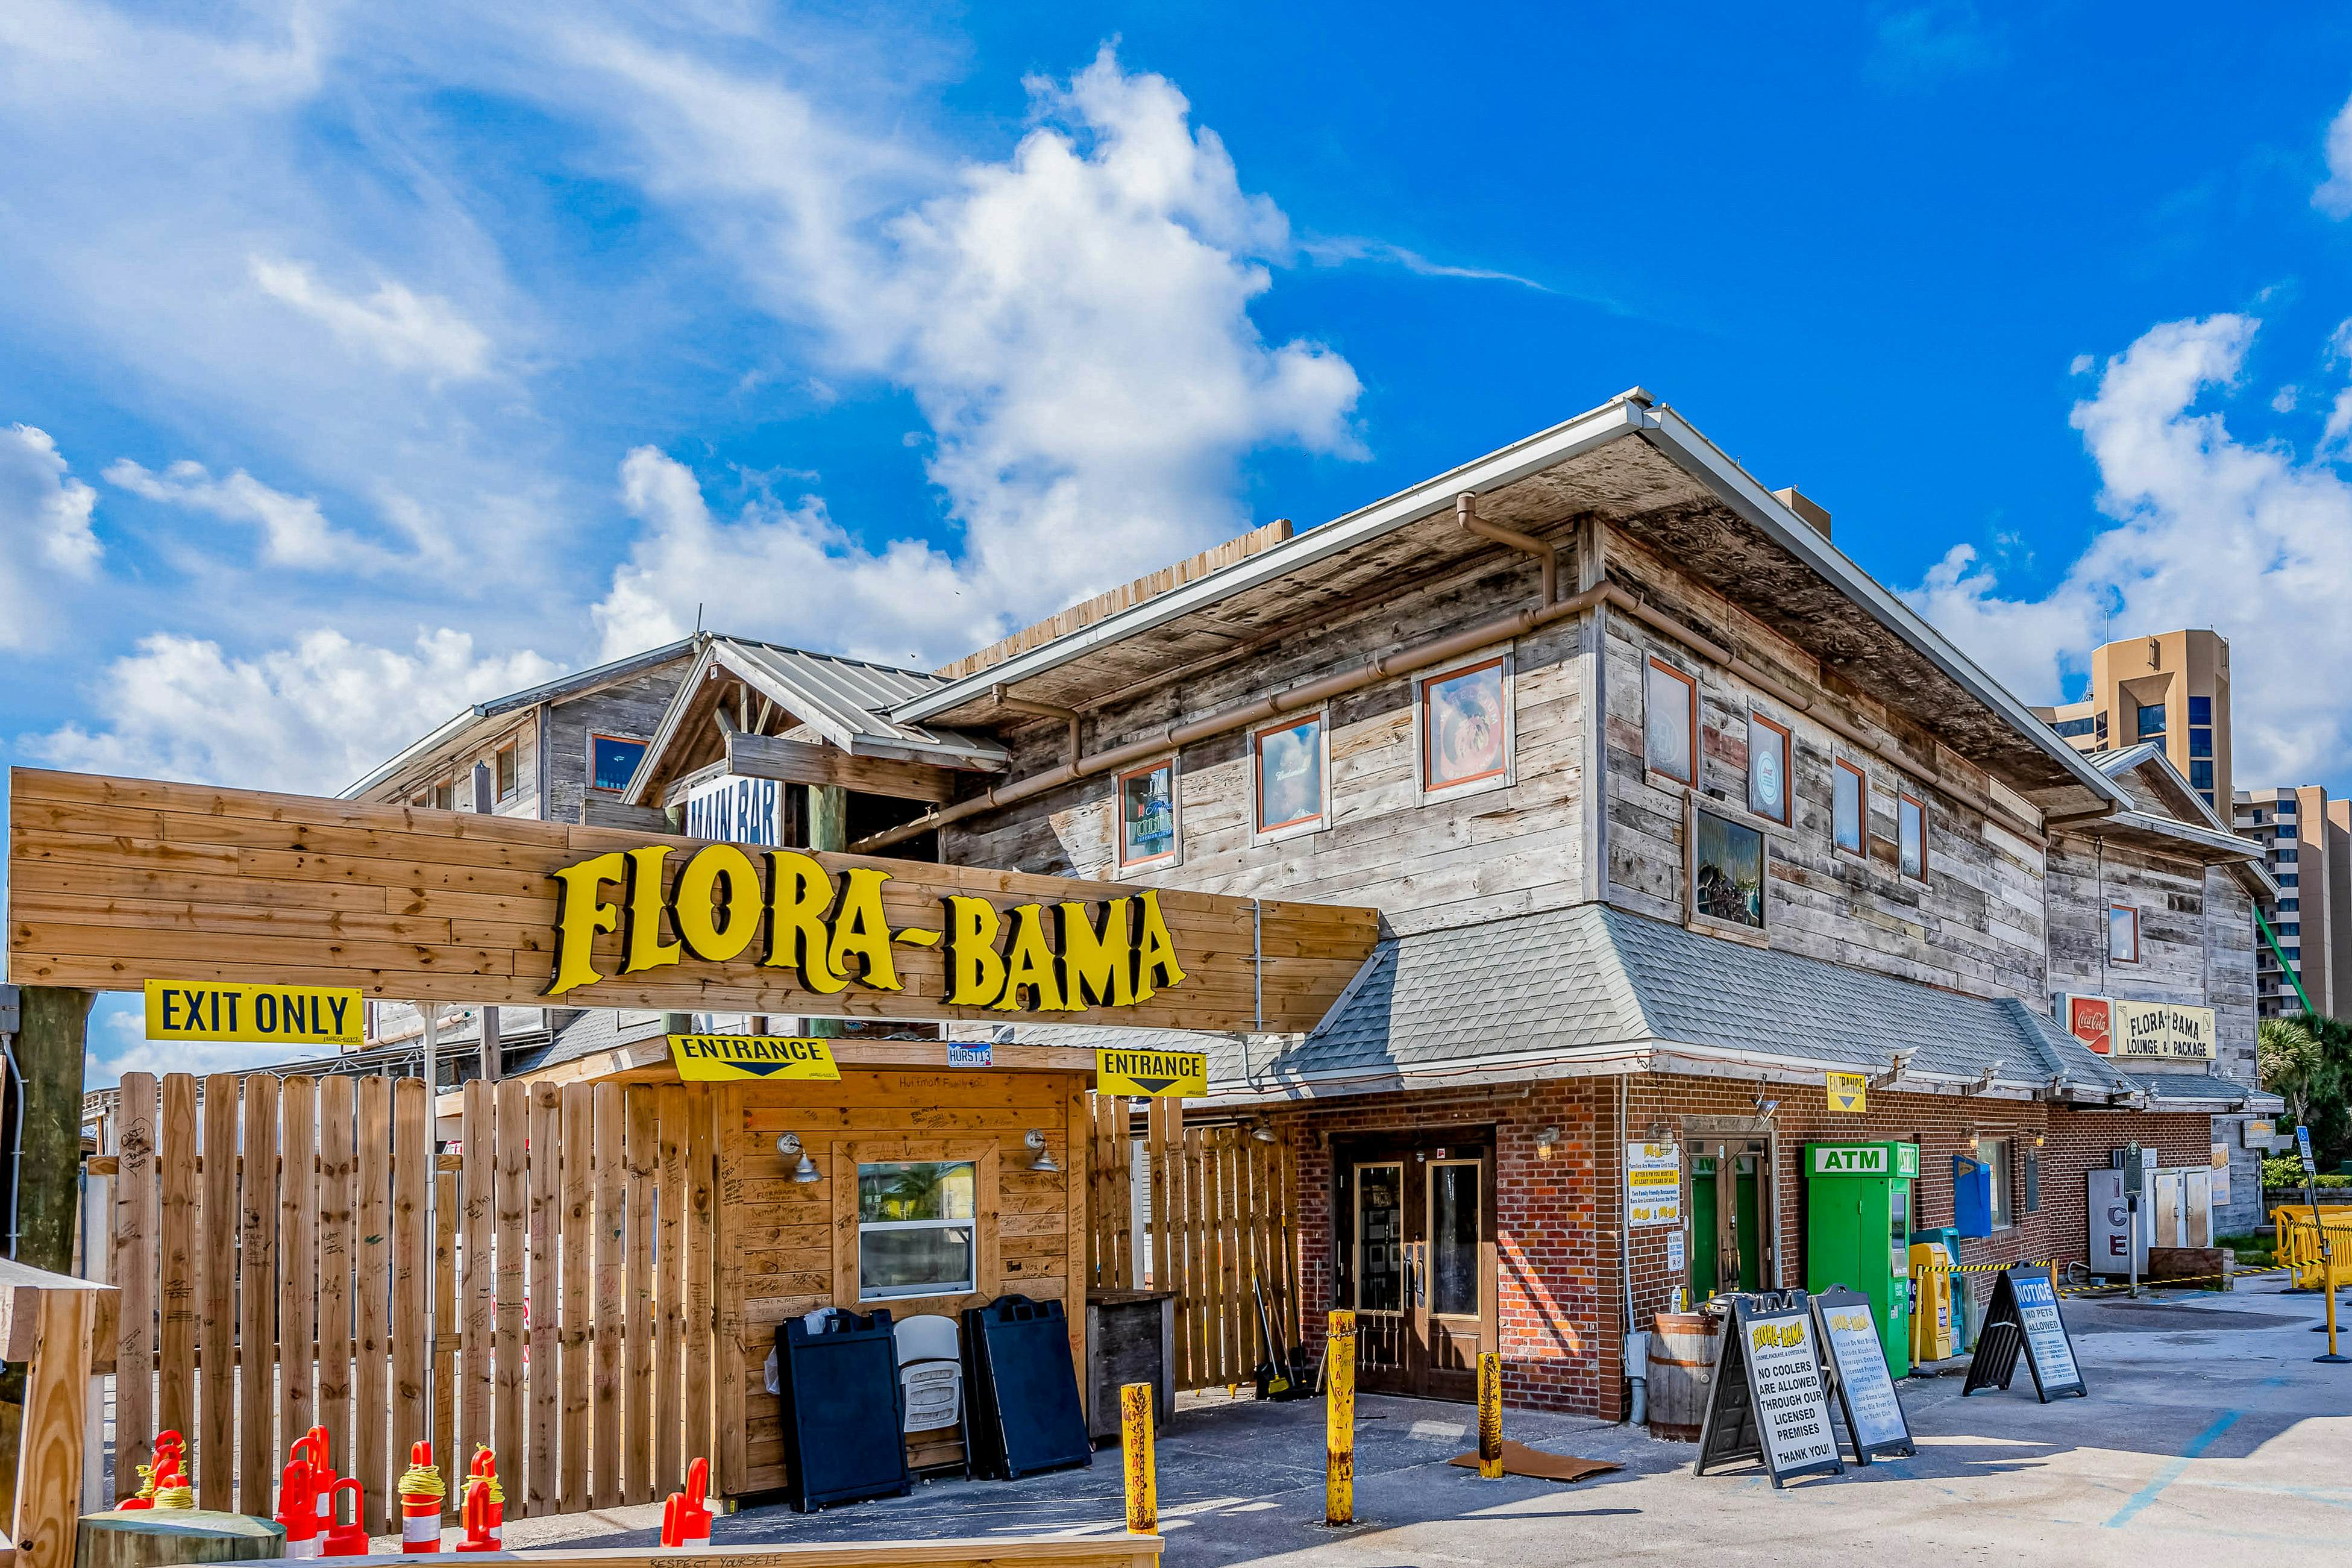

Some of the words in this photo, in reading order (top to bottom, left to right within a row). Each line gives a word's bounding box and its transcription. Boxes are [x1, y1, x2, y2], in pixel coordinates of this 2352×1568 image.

[691, 785, 733, 841] MAIN
[738, 779, 775, 846] BAR
[162, 989, 242, 1033] EXIT
[255, 993, 348, 1035] ONLY
[680, 1038, 824, 1061] ENTRANCE
[2127, 1038, 2158, 1055] LOUNGE
[2163, 1041, 2168, 1053] &
[2174, 1041, 2206, 1057] PACKAGE
[1105, 1053, 1200, 1077] ENTRANCE
[1830, 1076, 1863, 1095] ENTRANCE
[1824, 1150, 1879, 1170] ATM
[1901, 1152, 1915, 1170] ATM
[2015, 1282, 2054, 1303] NOTICE
[2025, 1309, 2036, 1319] NO
[2036, 1308, 2053, 1317] PETS
[2028, 1320, 2058, 1332] ALLOWED
[1752, 1320, 1805, 1353] FLORA-BAMA
[1758, 1368, 1770, 1380] NO
[1773, 1361, 1811, 1377] COOLERS
[1760, 1382, 1776, 1396] ARE
[1778, 1376, 1817, 1393] ALLOWED
[1761, 1394, 1802, 1411] THROUGH
[1804, 1391, 1824, 1403] OUR
[1774, 1408, 1816, 1425] LICENSED
[1777, 1423, 1820, 1441] PREMISES
[1778, 1448, 1808, 1464] THANK
[1808, 1443, 1831, 1458] YOU!
[649, 1558, 710, 1568] RESPECT
[720, 1553, 783, 1568] YOURSELF
